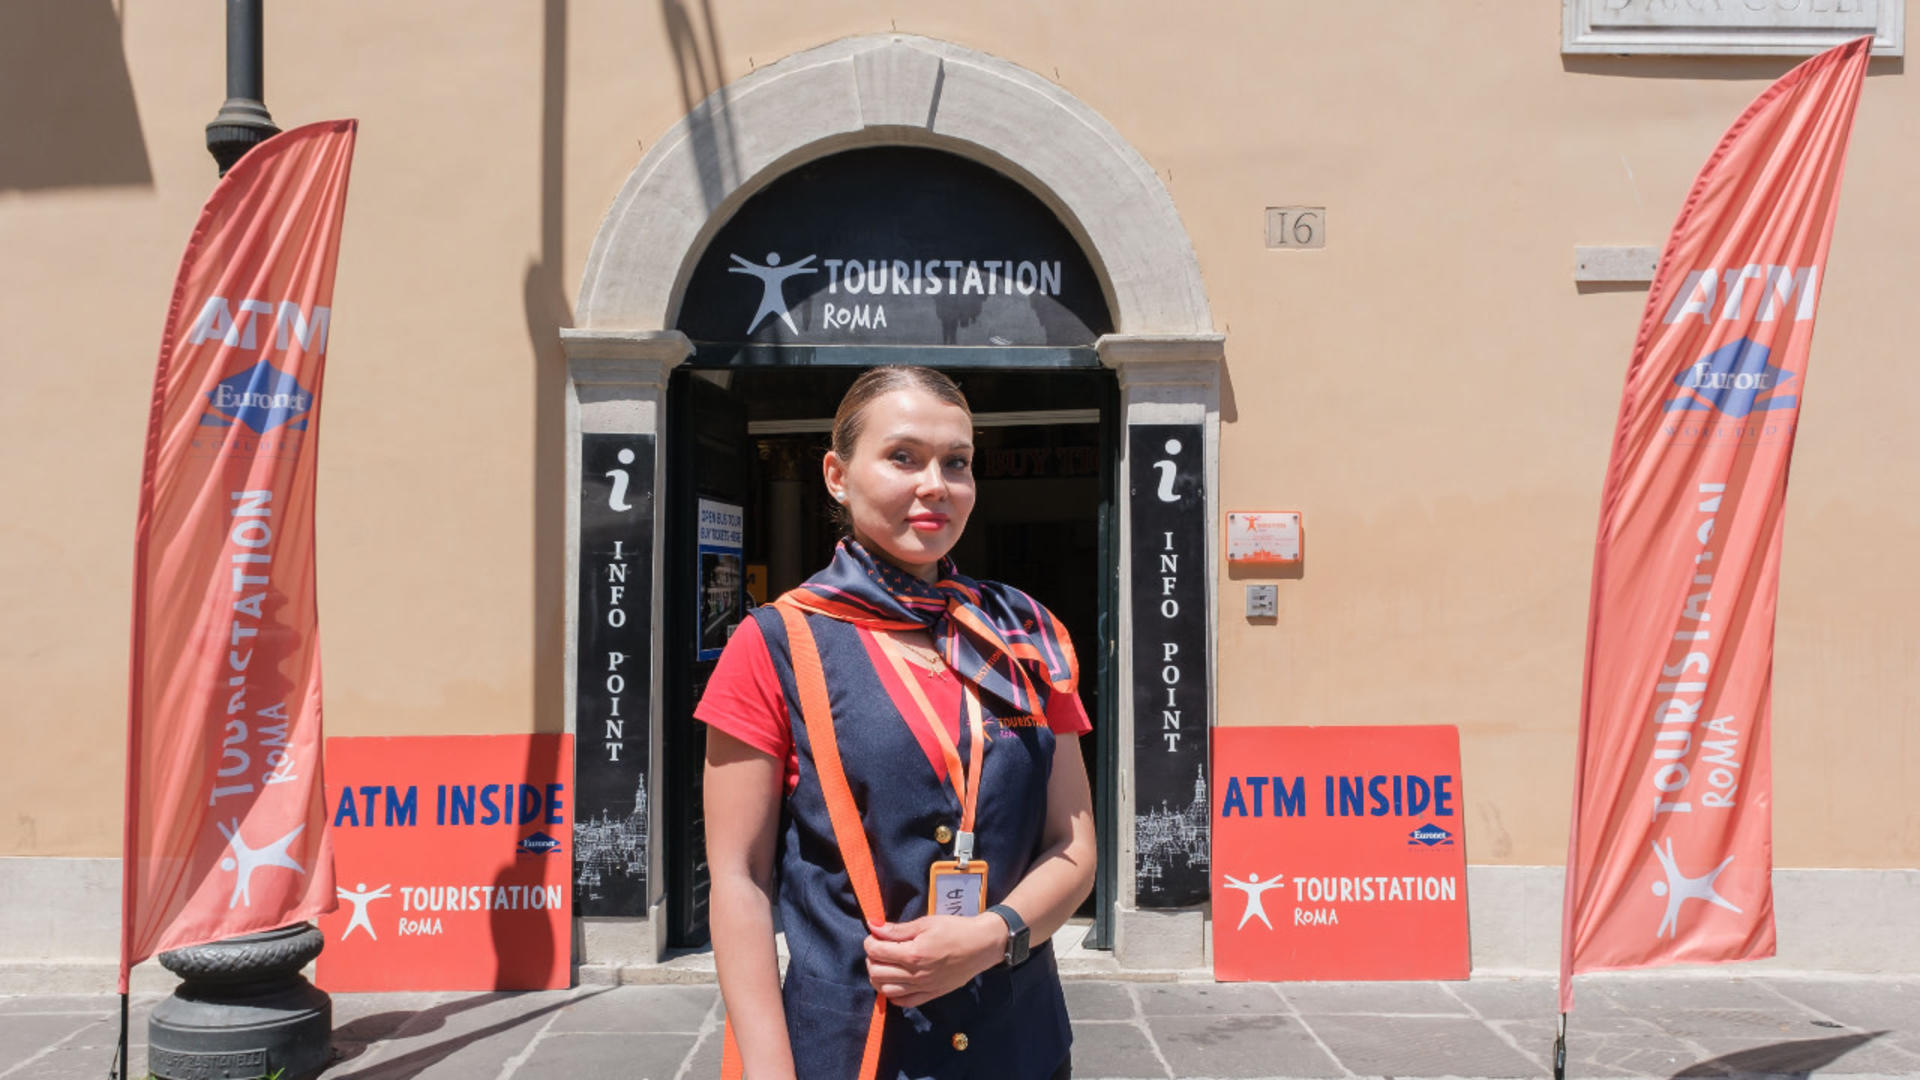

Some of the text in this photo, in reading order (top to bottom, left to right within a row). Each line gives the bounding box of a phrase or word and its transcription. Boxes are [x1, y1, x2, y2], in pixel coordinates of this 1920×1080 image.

[1277, 212, 1318, 244] 16
[824, 258, 1061, 296] TOURISTATION
[1662, 263, 1817, 325] ATM
[188, 296, 331, 355] ATM
[823, 303, 887, 330] ROMA
[701, 509, 716, 523] OPEN
[701, 527, 711, 540] BUY
[608, 541, 627, 628] INFO
[1160, 532, 1179, 619] INFO
[605, 651, 625, 761] POINT
[1162, 642, 1181, 752] POINT
[257, 702, 297, 784] ROMA
[1701, 715, 1740, 808] ROMA
[333, 783, 564, 827] ATM INSIDE
[1222, 775, 1454, 817] ATM INSIDE
[523, 838, 556, 847] Euronet
[1413, 830, 1447, 840] Euronet
[400, 885, 562, 912] TOURISTATION
[1293, 876, 1456, 902] TOURISTATION
[398, 917, 443, 936] ROMA
[1294, 907, 1338, 926] ROMA
